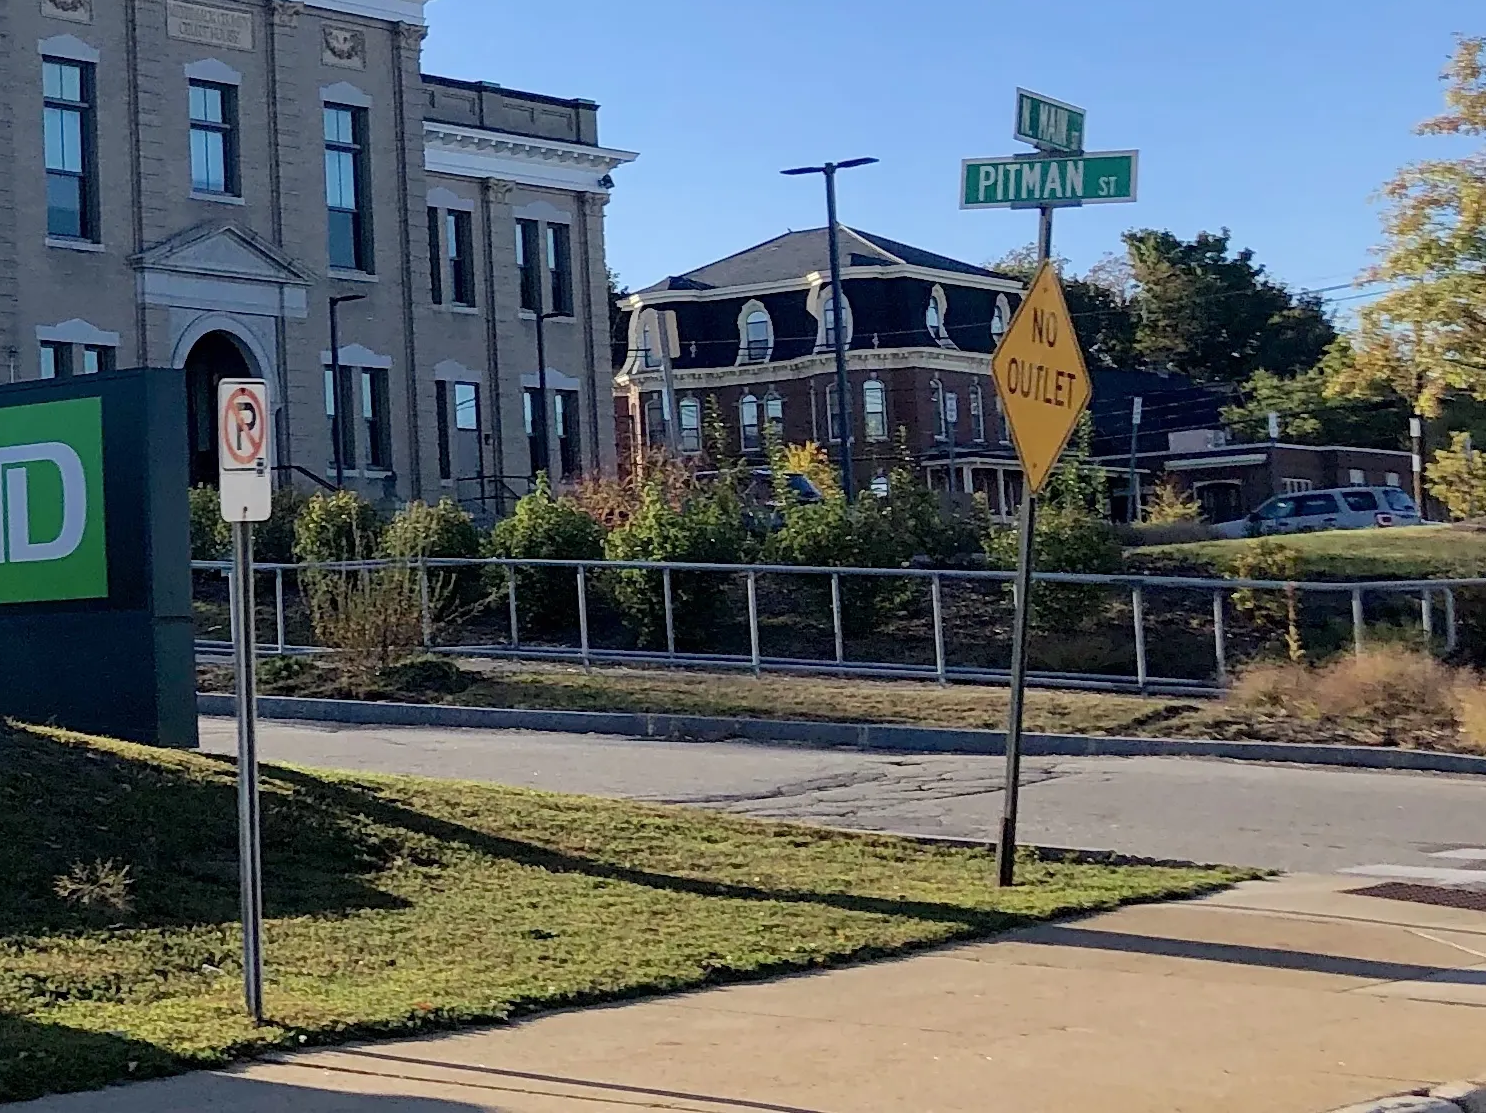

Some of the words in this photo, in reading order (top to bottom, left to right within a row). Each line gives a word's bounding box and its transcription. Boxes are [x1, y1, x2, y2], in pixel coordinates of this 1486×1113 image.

[978, 160, 1084, 201] PITMAN
[1098, 176, 1118, 196] ST
[1032, 306, 1058, 348] NO
[1007, 357, 1076, 409] OUTLET
[236, 402, 257, 451] P
